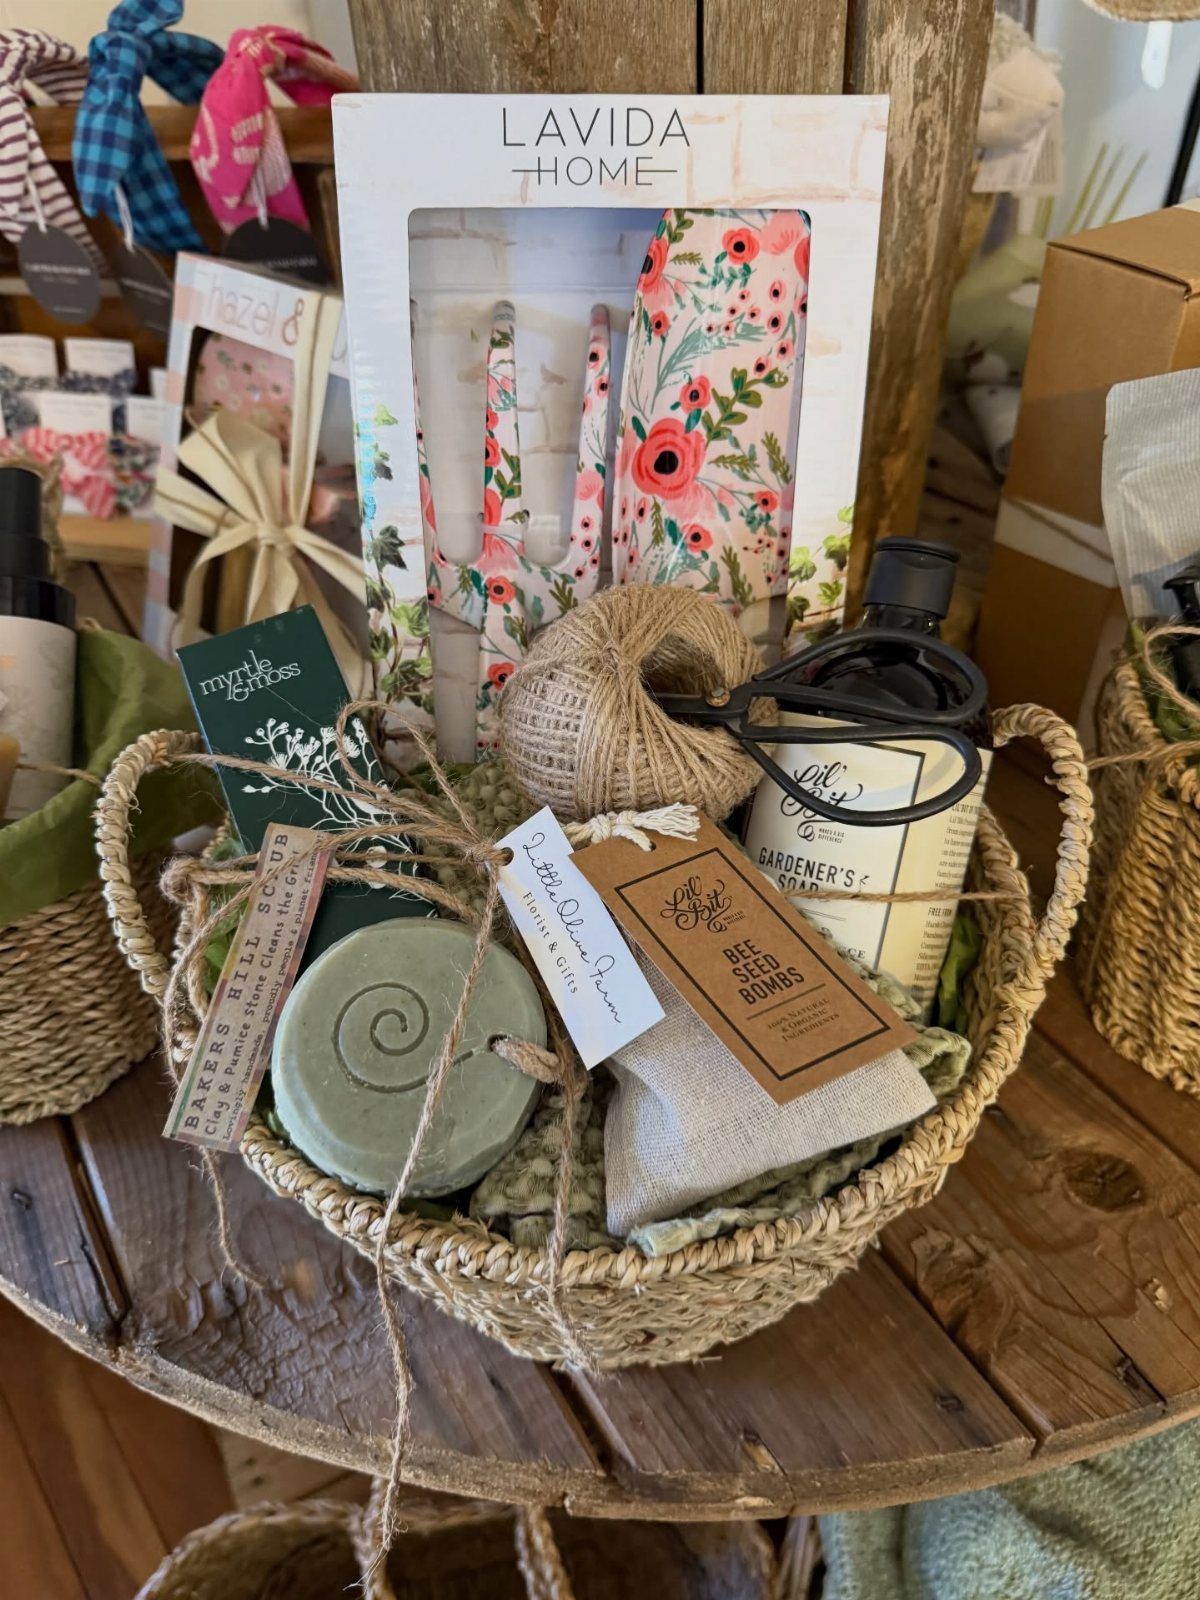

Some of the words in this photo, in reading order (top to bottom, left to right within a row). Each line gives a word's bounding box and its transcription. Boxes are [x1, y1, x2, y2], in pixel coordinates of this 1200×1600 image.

[503, 107, 690, 147] LAVIDA
[512, 156, 677, 186] HOME
[207, 272, 280, 339] hazel
[282, 298, 305, 346] &
[200, 650, 273, 700] myrtle
[285, 850, 300, 886] Gri!
[759, 847, 855, 888] GARDENER'S
[278, 891, 293, 916] the
[660, 875, 702, 918] Lil'
[260, 921, 285, 969] Cleans
[522, 832, 562, 904] Little
[557, 898, 590, 964] Olive
[590, 954, 622, 1024] Farm
[522, 891, 550, 939] Florist
[548, 941, 557, 953] &
[556, 956, 579, 994] Gifts
[722, 939, 762, 965] BEE
[732, 953, 780, 984] SEED
[184, 1023, 230, 1130] BAKERS
[228, 936, 261, 1001] HILL
[258, 834, 289, 914] SCUB
[222, 1088, 247, 1141] Lovingly
[262, 980, 283, 1024] proudly
[279, 941, 294, 977] people
[295, 888, 309, 926] planet
[304, 834, 324, 884] frieny!
[738, 966, 805, 1005] BOMBS
[224, 1022, 251, 1076] Pumice
[219, 1082, 231, 1094] &
[205, 1100, 231, 1136] Clay
